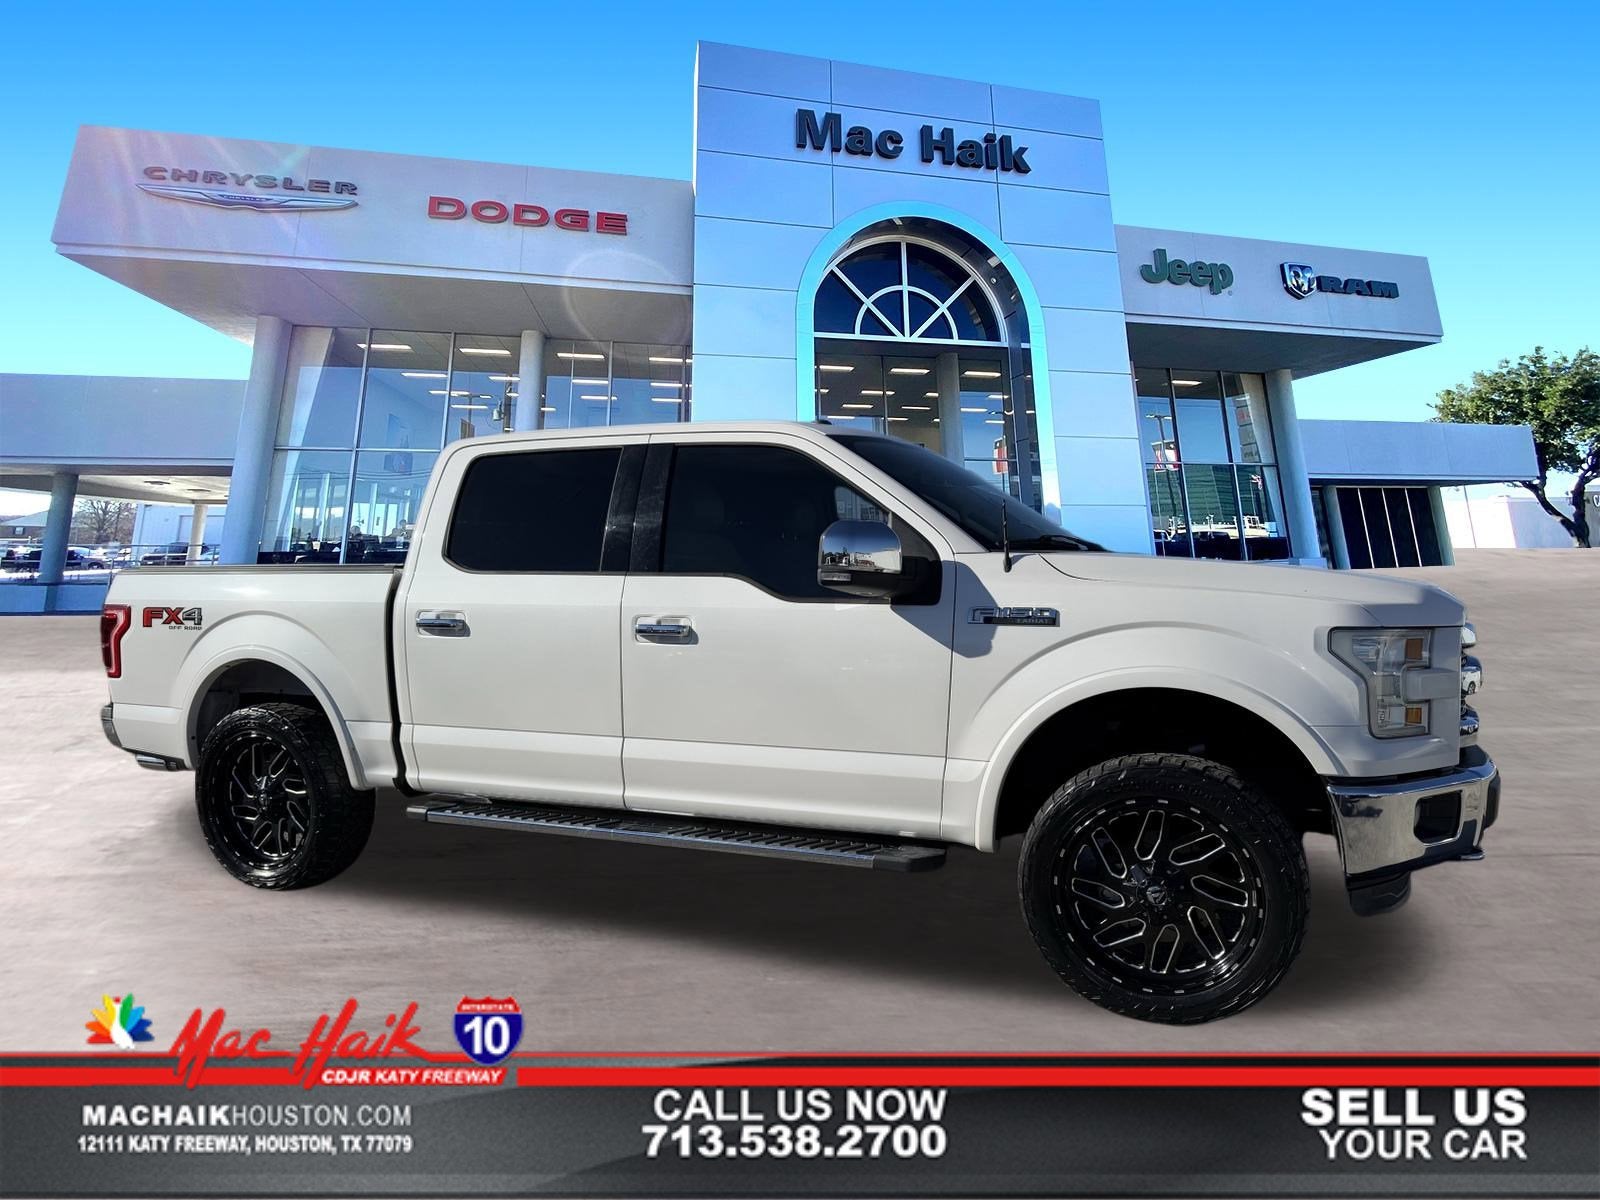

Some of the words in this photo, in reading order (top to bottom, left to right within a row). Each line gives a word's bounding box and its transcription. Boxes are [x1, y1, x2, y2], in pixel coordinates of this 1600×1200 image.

[796, 108, 904, 160] Mac
[919, 124, 1032, 174] Haik
[143, 166, 358, 196] CHRYSLER
[428, 195, 629, 236] DODGE
[1140, 248, 1234, 296] Jeep
[1316, 275, 1400, 299] RAM
[142, 606, 203, 628] FX4
